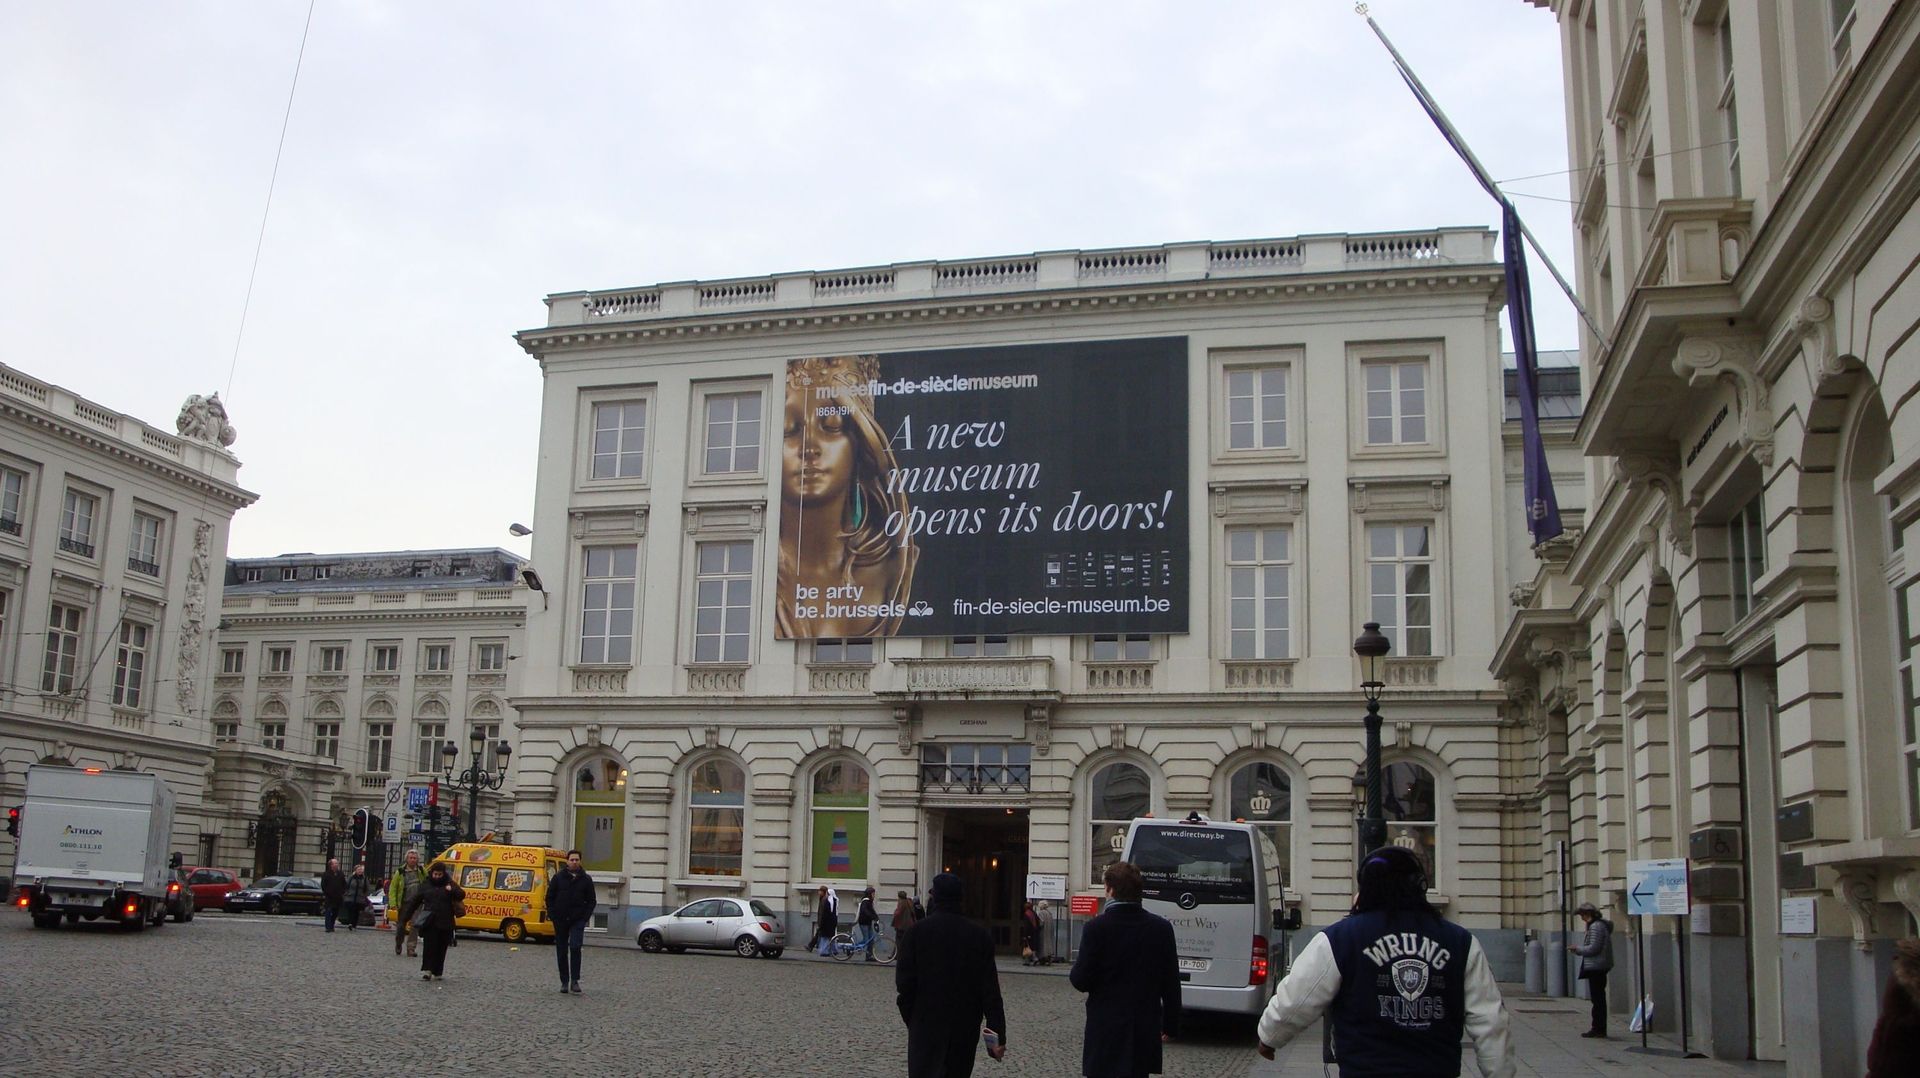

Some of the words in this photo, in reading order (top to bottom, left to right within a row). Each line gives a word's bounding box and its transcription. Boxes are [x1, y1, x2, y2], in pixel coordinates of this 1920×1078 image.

[882, 414, 915, 451] A
[927, 421, 1005, 450] new
[887, 462, 1040, 494] museum
[884, 505, 986, 547] opens
[998, 493, 1042, 533] its
[1052, 490, 1173, 531] doors!
[796, 583, 819, 600] be
[826, 583, 863, 601] arty
[953, 594, 1171, 616] fin-de-siecle-museum.be
[595, 818, 614, 831] ART
[1161, 830, 1225, 840] www.directway.be
[501, 851, 538, 864] GLACES
[465, 892, 487, 901] ACES
[491, 893, 530, 904] GAUFRES
[1195, 917, 1220, 933] Way
[1362, 932, 1451, 970] WRUNG
[1180, 960, 1205, 968] IP-700
[1377, 995, 1444, 1019] KINGS
